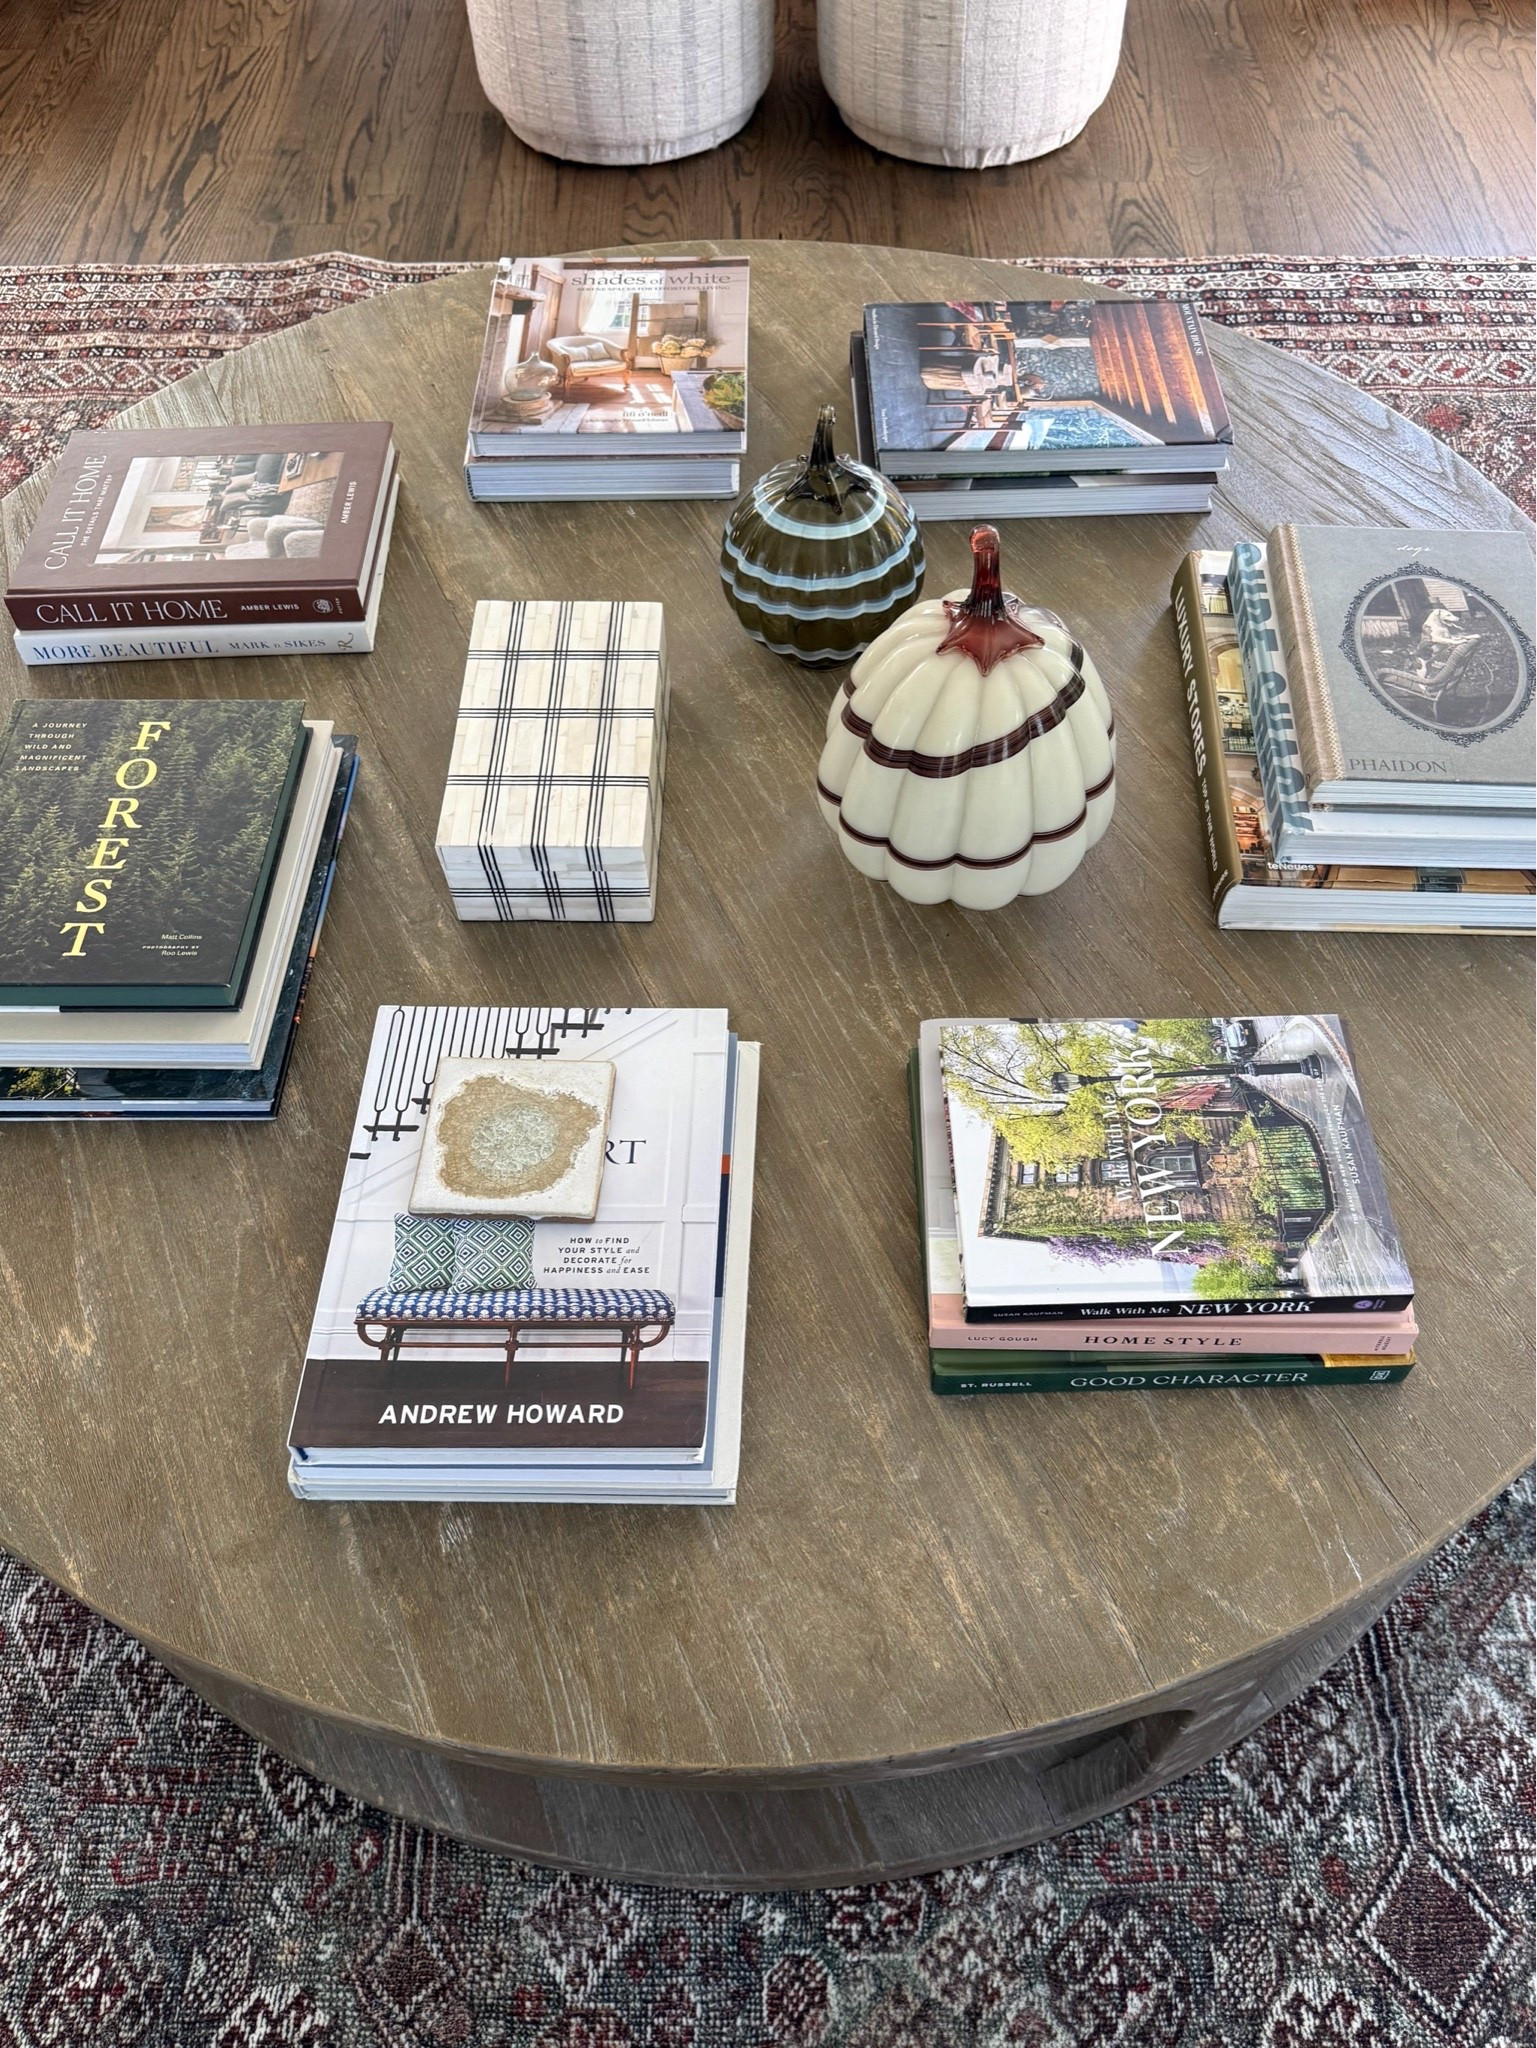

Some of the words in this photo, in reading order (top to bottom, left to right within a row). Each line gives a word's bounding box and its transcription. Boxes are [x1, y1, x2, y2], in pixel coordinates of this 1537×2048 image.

[571, 273, 646, 286] shades
[650, 277, 664, 285] of
[669, 272, 731, 284] white
[69, 455, 107, 504] HOME
[345, 481, 357, 501] LEWIS
[61, 507, 86, 523] IT
[85, 511, 100, 534] DETAILS
[340, 501, 353, 524] AMBER
[44, 526, 80, 570] CALL
[80, 535, 91, 546] THE
[36, 603, 108, 624] CALL
[110, 602, 135, 622] IT
[141, 600, 228, 621] HOME
[240, 604, 270, 612] AMBER
[272, 603, 300, 611] LEWIS
[33, 644, 96, 661] MORE
[99, 639, 219, 659] BEAUTIFUL
[229, 641, 270, 650] MARK
[284, 639, 326, 648] SIKES
[1174, 586, 1194, 679] LUXURY
[1186, 678, 1207, 777] STORES
[1209, 833, 1218, 871] WORLD
[1349, 758, 1447, 774] PHAIDON
[59, 721, 171, 957] FOREST
[1102, 1094, 1120, 1122] Me
[1115, 1046, 1167, 1163] YORK
[1332, 1105, 1351, 1149] KAUFMAN
[1106, 1122, 1127, 1160] With
[1114, 1158, 1134, 1202] Walk
[1346, 1153, 1360, 1184] SUSAN
[1135, 1164, 1190, 1256] NEW
[618, 1255, 632, 1266] for
[625, 1246, 640, 1254] and
[543, 1266, 603, 1274] HAPPINESS
[606, 1265, 621, 1274] and
[623, 1266, 650, 1274] EASE
[1080, 1307, 1112, 1316] Walk
[1115, 1306, 1146, 1315] With
[1149, 1306, 1170, 1314] Me
[1177, 1303, 1239, 1315] NEW
[1244, 1301, 1315, 1313] YORK
[1084, 1336, 1156, 1345] HOME
[1163, 1337, 1242, 1346] STYLE
[1070, 1376, 1146, 1387] GOOD
[1153, 1372, 1309, 1386] CHARACTER
[378, 1404, 498, 1424] ANDREW
[506, 1404, 624, 1424] HOWARD
